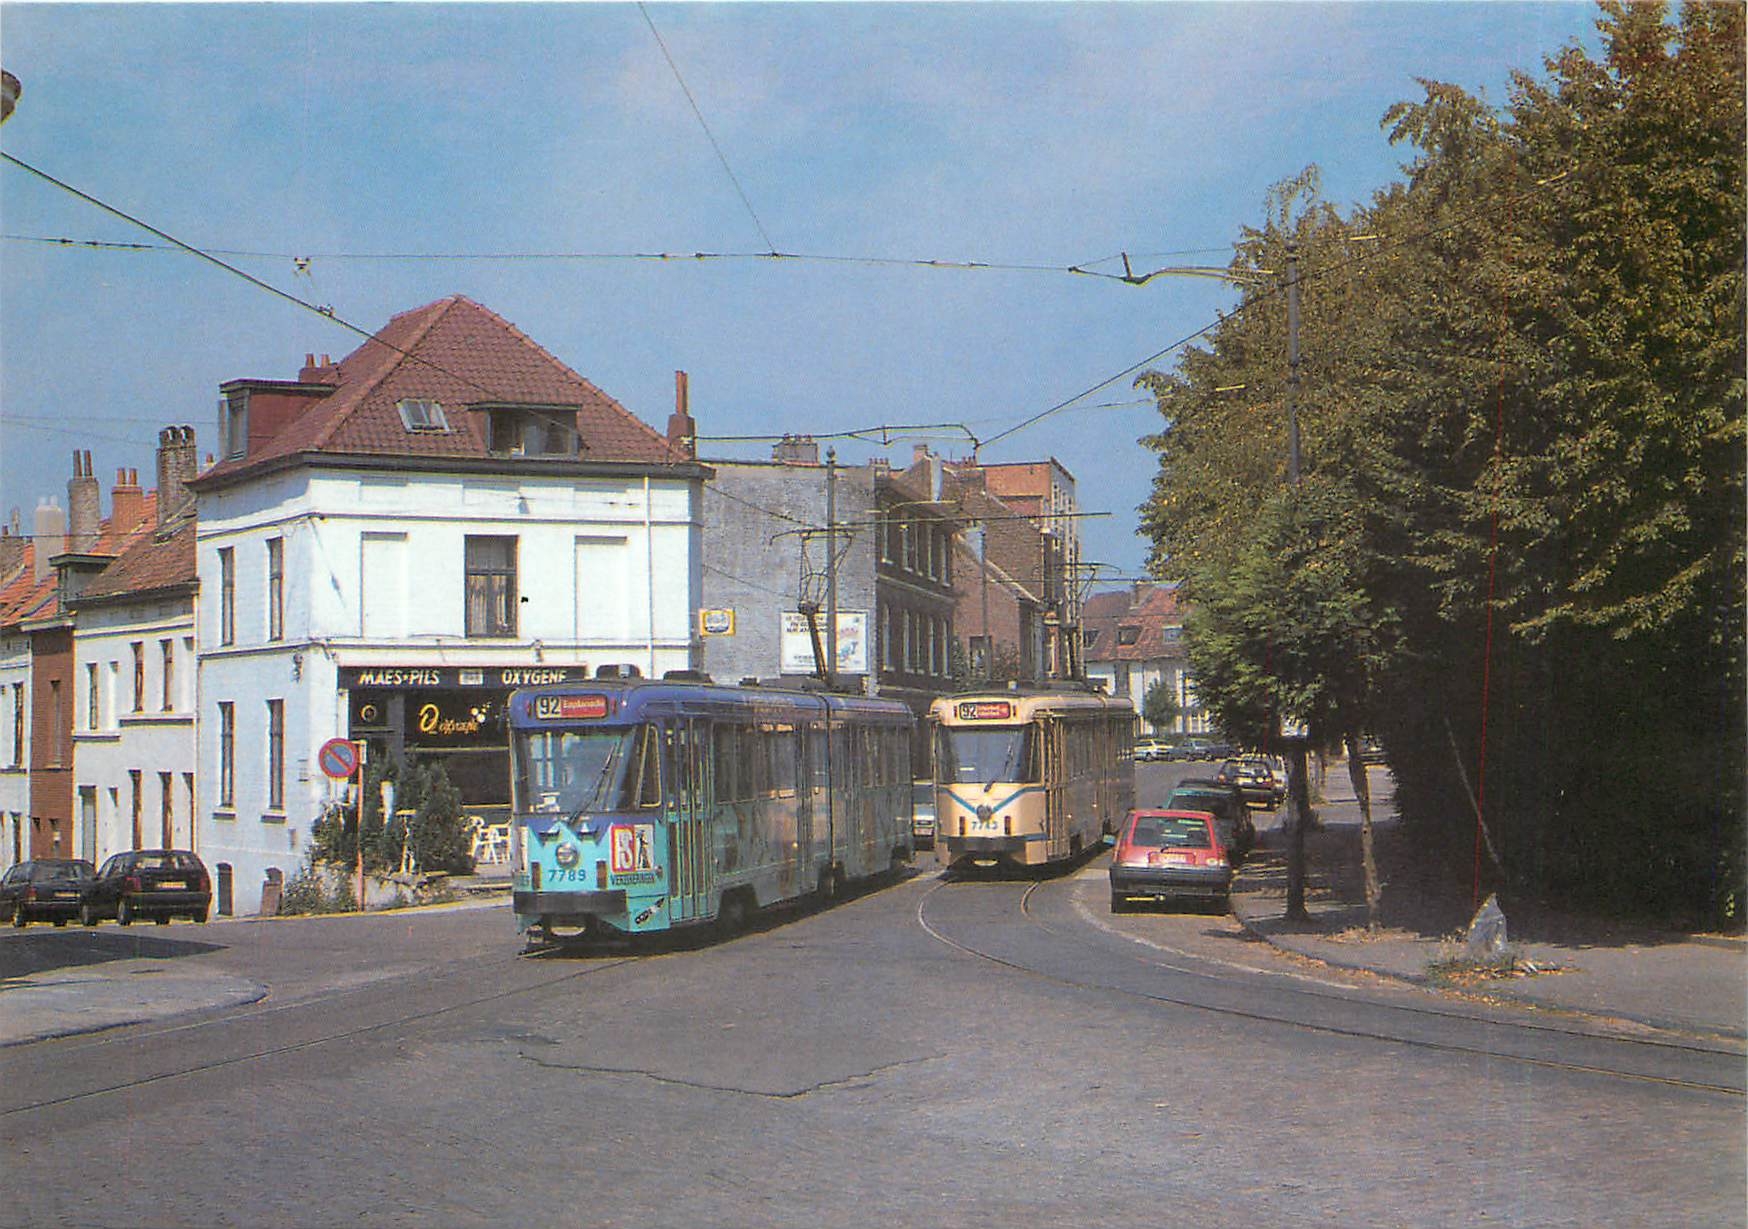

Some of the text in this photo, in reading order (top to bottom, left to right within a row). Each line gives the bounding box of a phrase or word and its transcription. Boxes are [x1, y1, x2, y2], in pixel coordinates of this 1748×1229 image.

[539, 697, 561, 715] 92
[962, 703, 977, 718] 92
[548, 869, 588, 883] 7789
